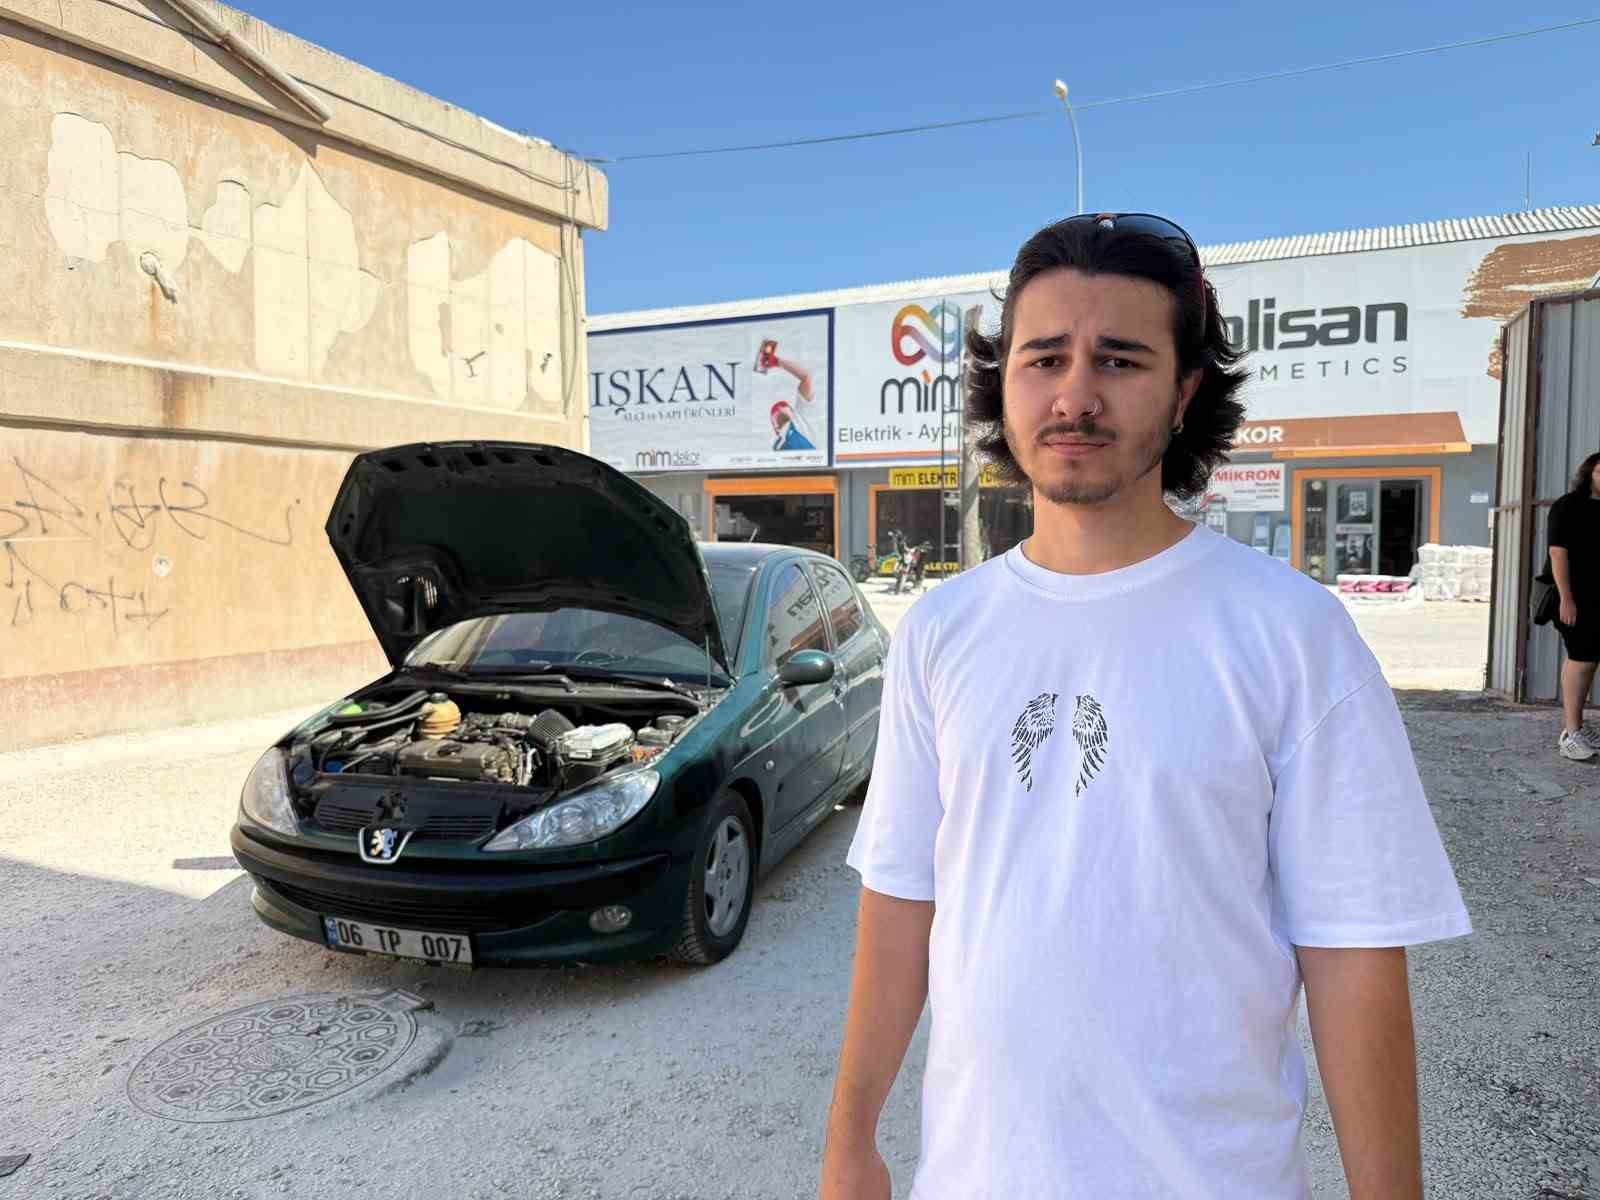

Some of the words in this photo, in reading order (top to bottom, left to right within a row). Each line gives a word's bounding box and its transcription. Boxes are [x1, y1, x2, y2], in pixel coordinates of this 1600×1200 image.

[838, 426, 901, 442] Elektrik
[1231, 427, 1284, 445] KOR
[637, 450, 672, 466] mim
[337, 920, 363, 946] 06
[374, 928, 402, 952] TP
[421, 934, 463, 961] 007
